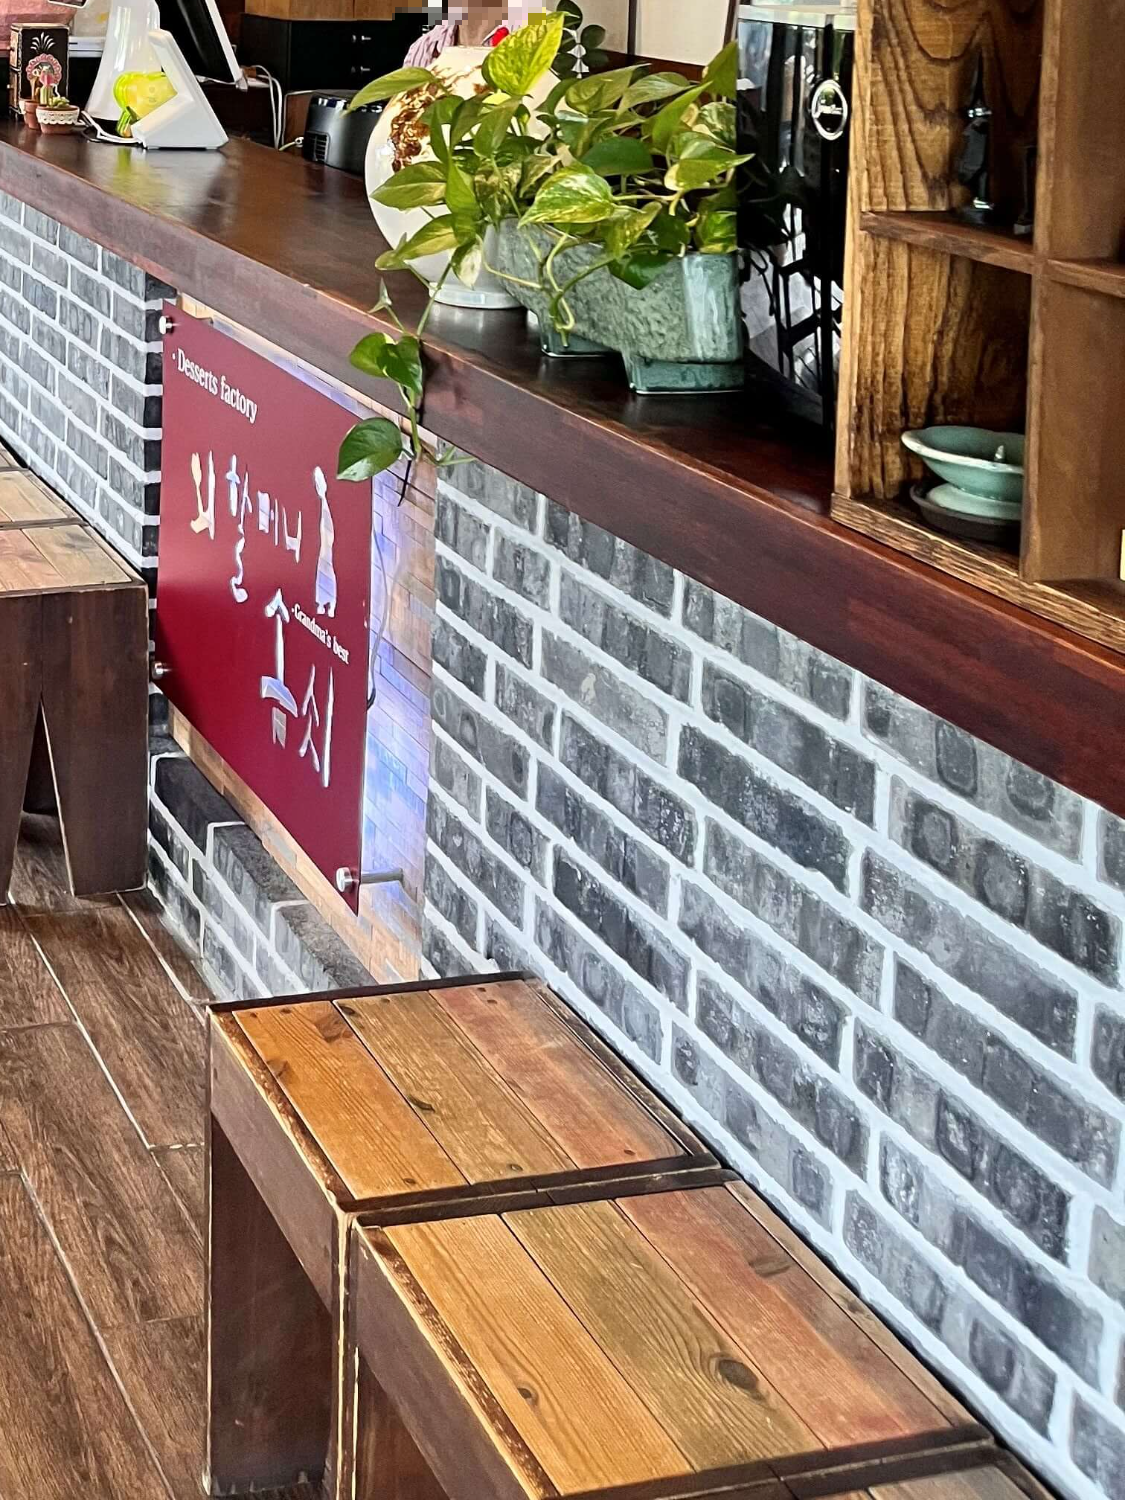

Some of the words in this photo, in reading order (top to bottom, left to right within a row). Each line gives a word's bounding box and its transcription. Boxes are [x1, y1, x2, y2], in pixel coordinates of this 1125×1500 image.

[177, 348, 219, 397] Desserts
[219, 374, 258, 424] factory
[293, 603, 332, 650] Grandma's
[332, 635, 350, 665] best
